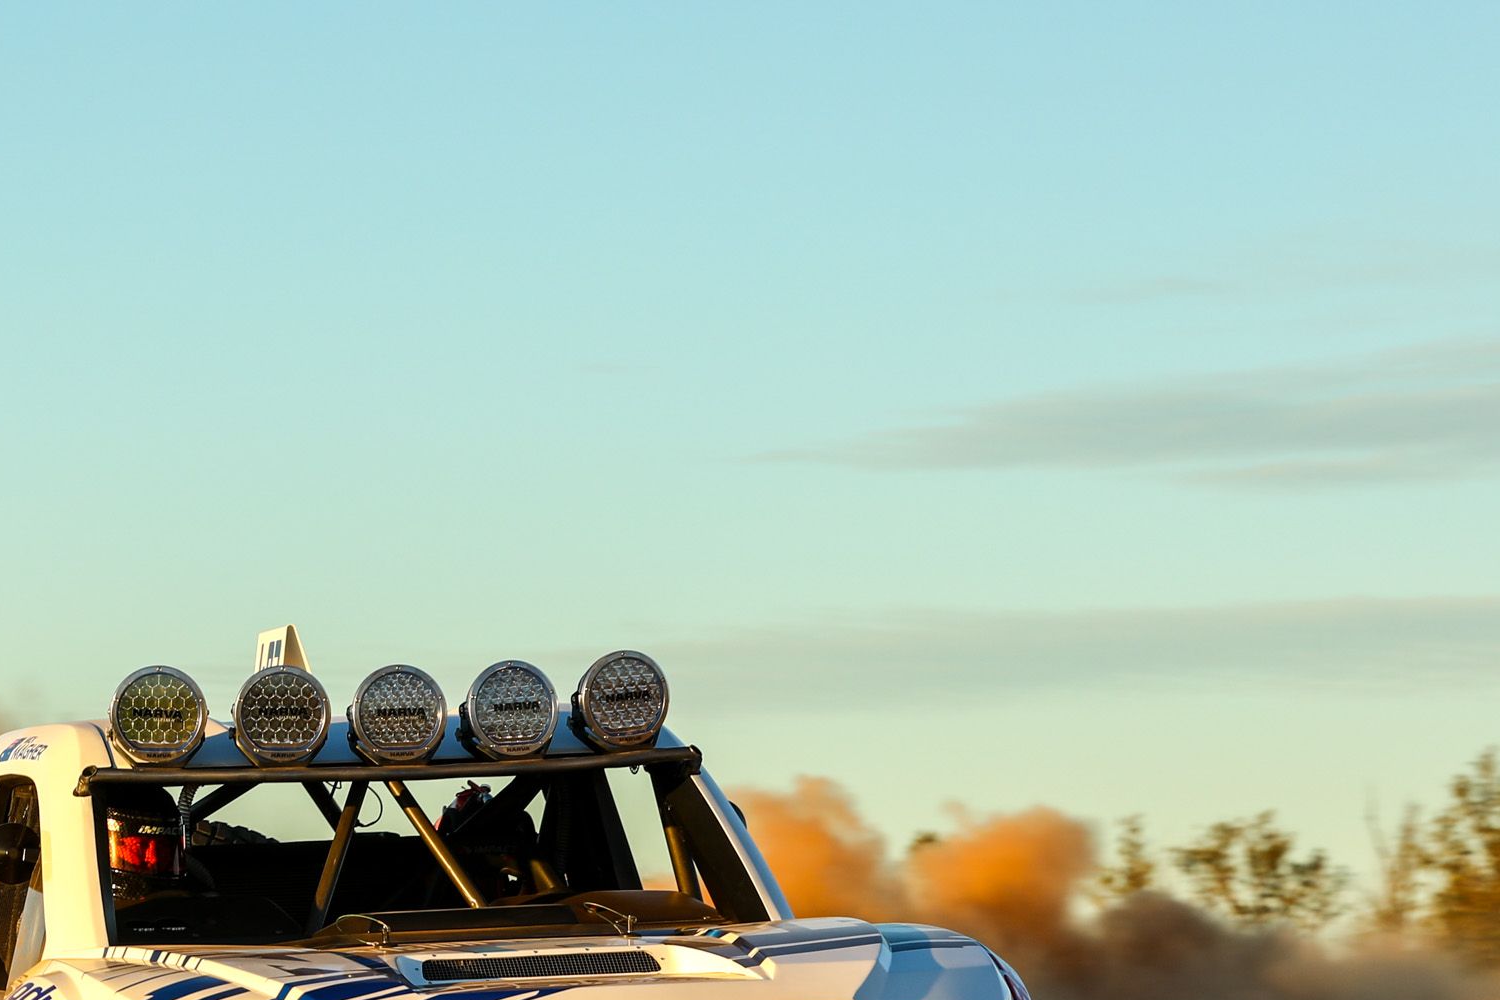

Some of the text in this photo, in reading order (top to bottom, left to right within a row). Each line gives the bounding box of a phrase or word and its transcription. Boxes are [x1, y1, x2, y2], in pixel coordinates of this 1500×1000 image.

[259, 707, 309, 719] NARVA
[377, 707, 425, 719] NARVA
[493, 701, 540, 713] NARVA
[132, 707, 183, 720] NARVA
[138, 824, 182, 836] IMPAC
